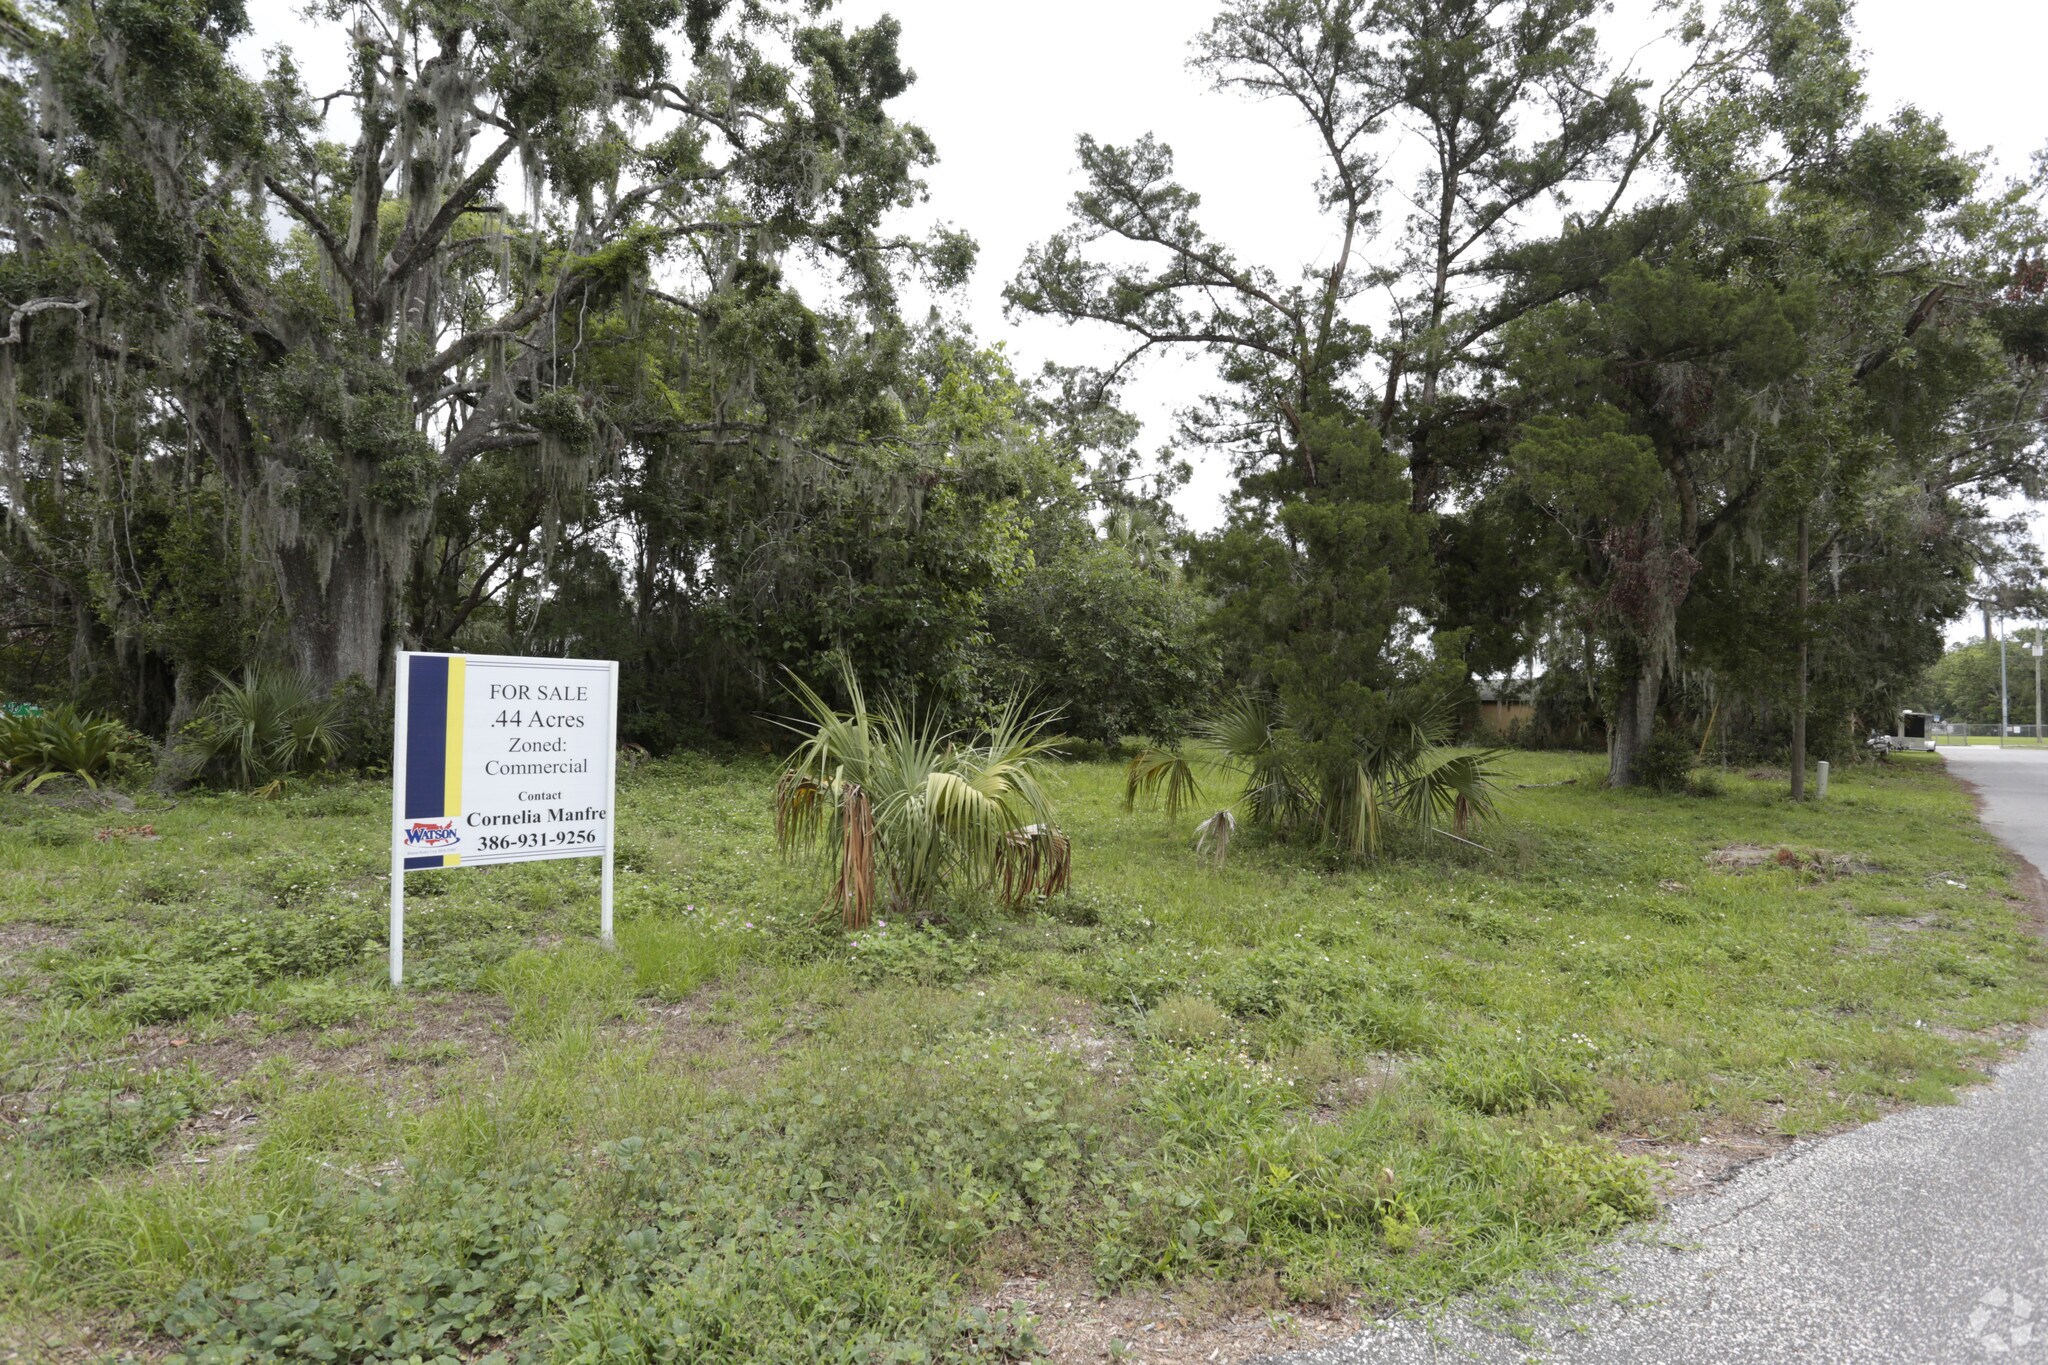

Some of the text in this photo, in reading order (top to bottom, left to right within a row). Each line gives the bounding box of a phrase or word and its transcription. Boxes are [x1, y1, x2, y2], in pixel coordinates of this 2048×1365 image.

[490, 684, 588, 701] FOR SALE
[491, 710, 584, 728] .44 Acres
[509, 738, 566, 752] Zoned:
[485, 759, 587, 775] Commercial
[518, 791, 561, 801] Contact
[467, 807, 606, 827] Cornelia Manfre
[405, 828, 458, 844] WATSON
[478, 830, 595, 851] 386-931-9256
